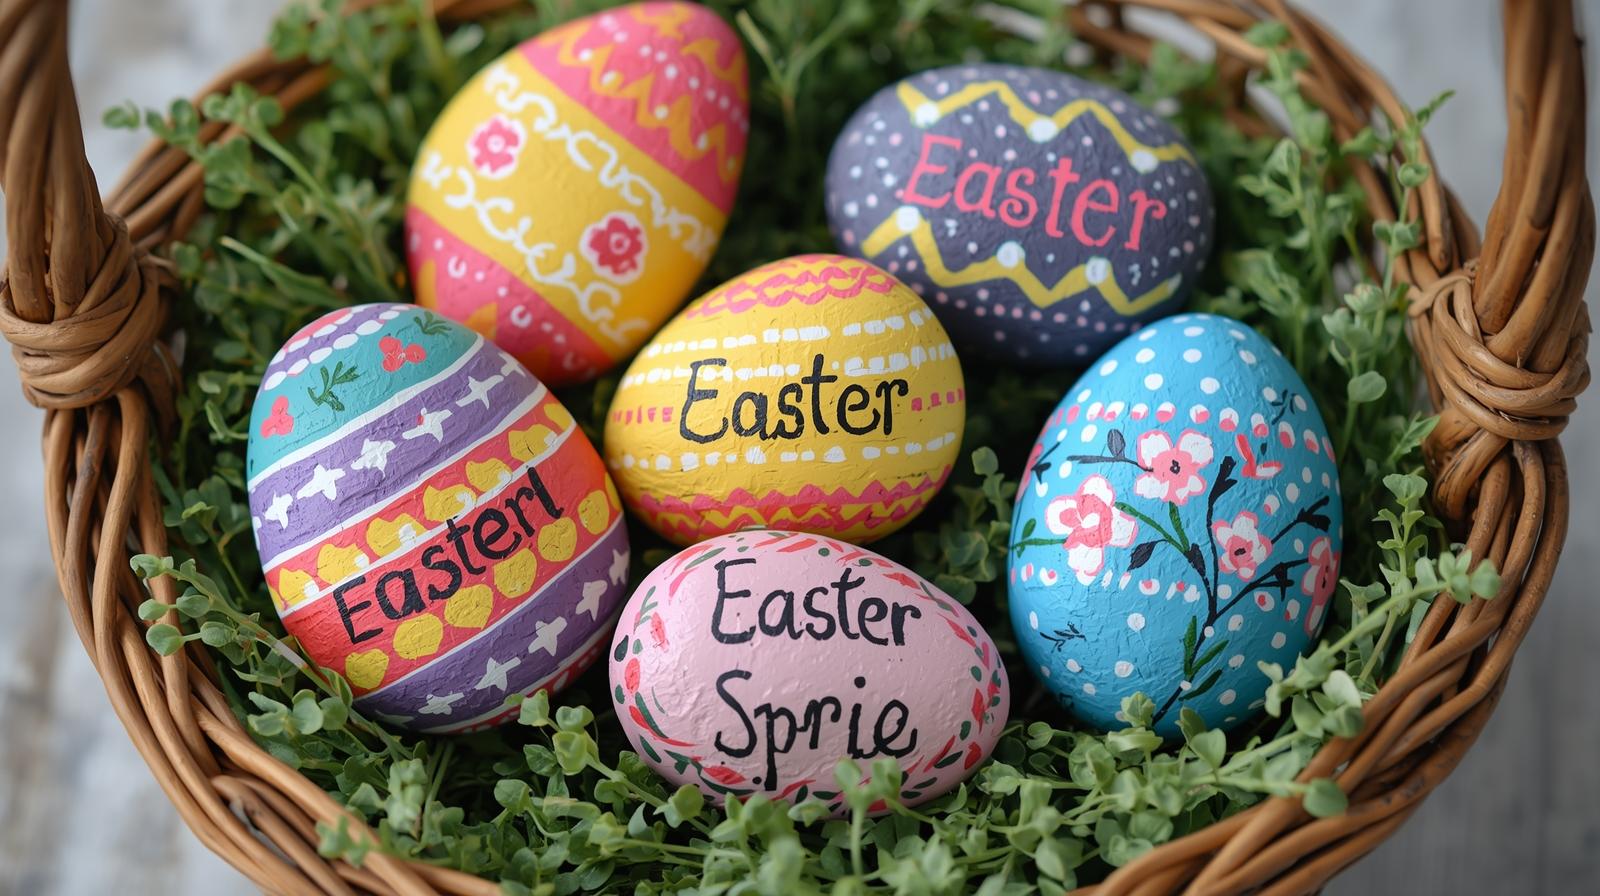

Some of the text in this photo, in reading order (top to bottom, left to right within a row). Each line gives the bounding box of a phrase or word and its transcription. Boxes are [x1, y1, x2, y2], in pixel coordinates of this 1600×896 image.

[902, 133, 1167, 250] Easter
[679, 353, 909, 444] Easter
[711, 558, 922, 646] Easter
[714, 669, 918, 791] Sprie
